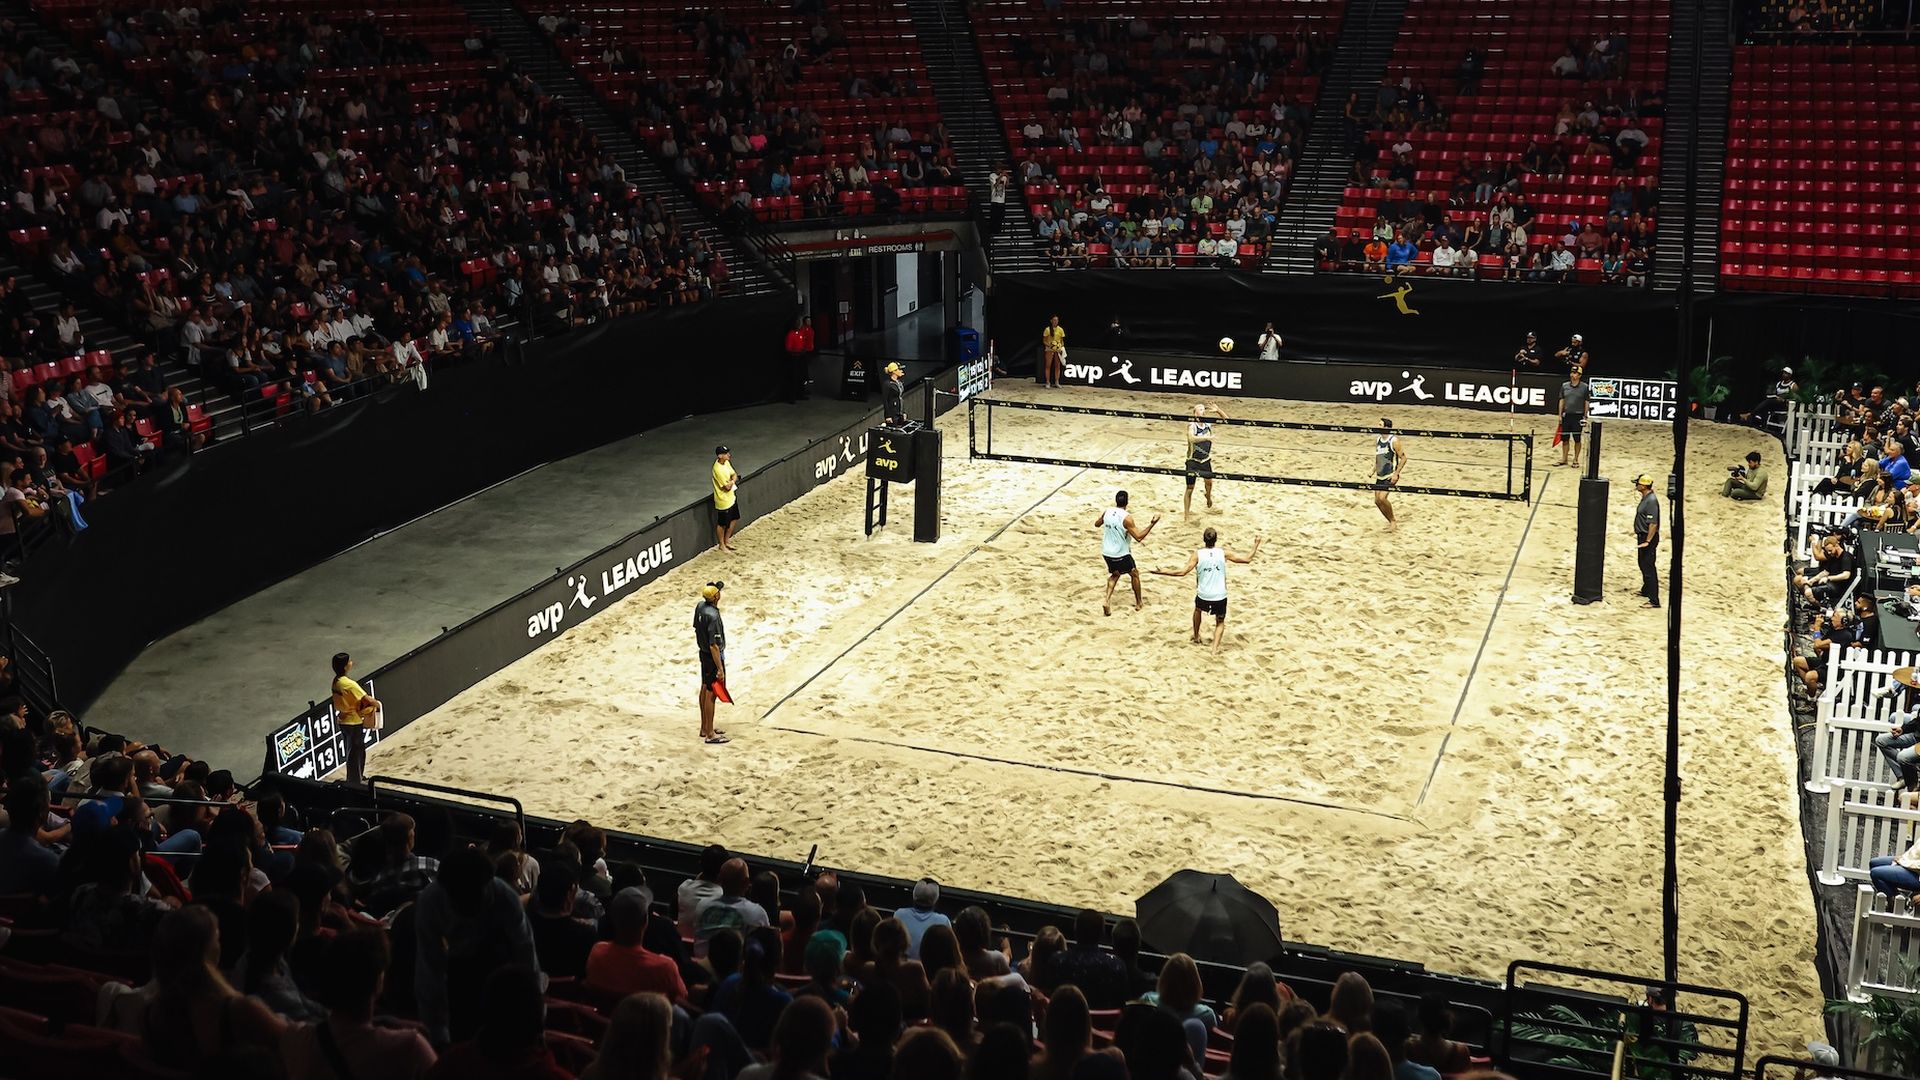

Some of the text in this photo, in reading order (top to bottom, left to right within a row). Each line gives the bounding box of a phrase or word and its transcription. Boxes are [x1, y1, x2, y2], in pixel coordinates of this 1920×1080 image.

[868, 243, 913, 253] RESTROOMS
[1064, 364, 1242, 389] avp LEAGUE
[1350, 379, 1546, 407] avp LEAGUE
[1624, 384, 1640, 397] 15
[1645, 385, 1660, 398] 12
[1669, 387, 1676, 399] 1
[1622, 404, 1638, 416] 13
[1643, 405, 1659, 418] 15
[1666, 406, 1676, 419] 2
[815, 454, 837, 479] avp
[875, 457, 899, 470] avp
[527, 537, 673, 638] avp LEAGUE
[313, 714, 331, 738] 15
[317, 747, 334, 770] 13
